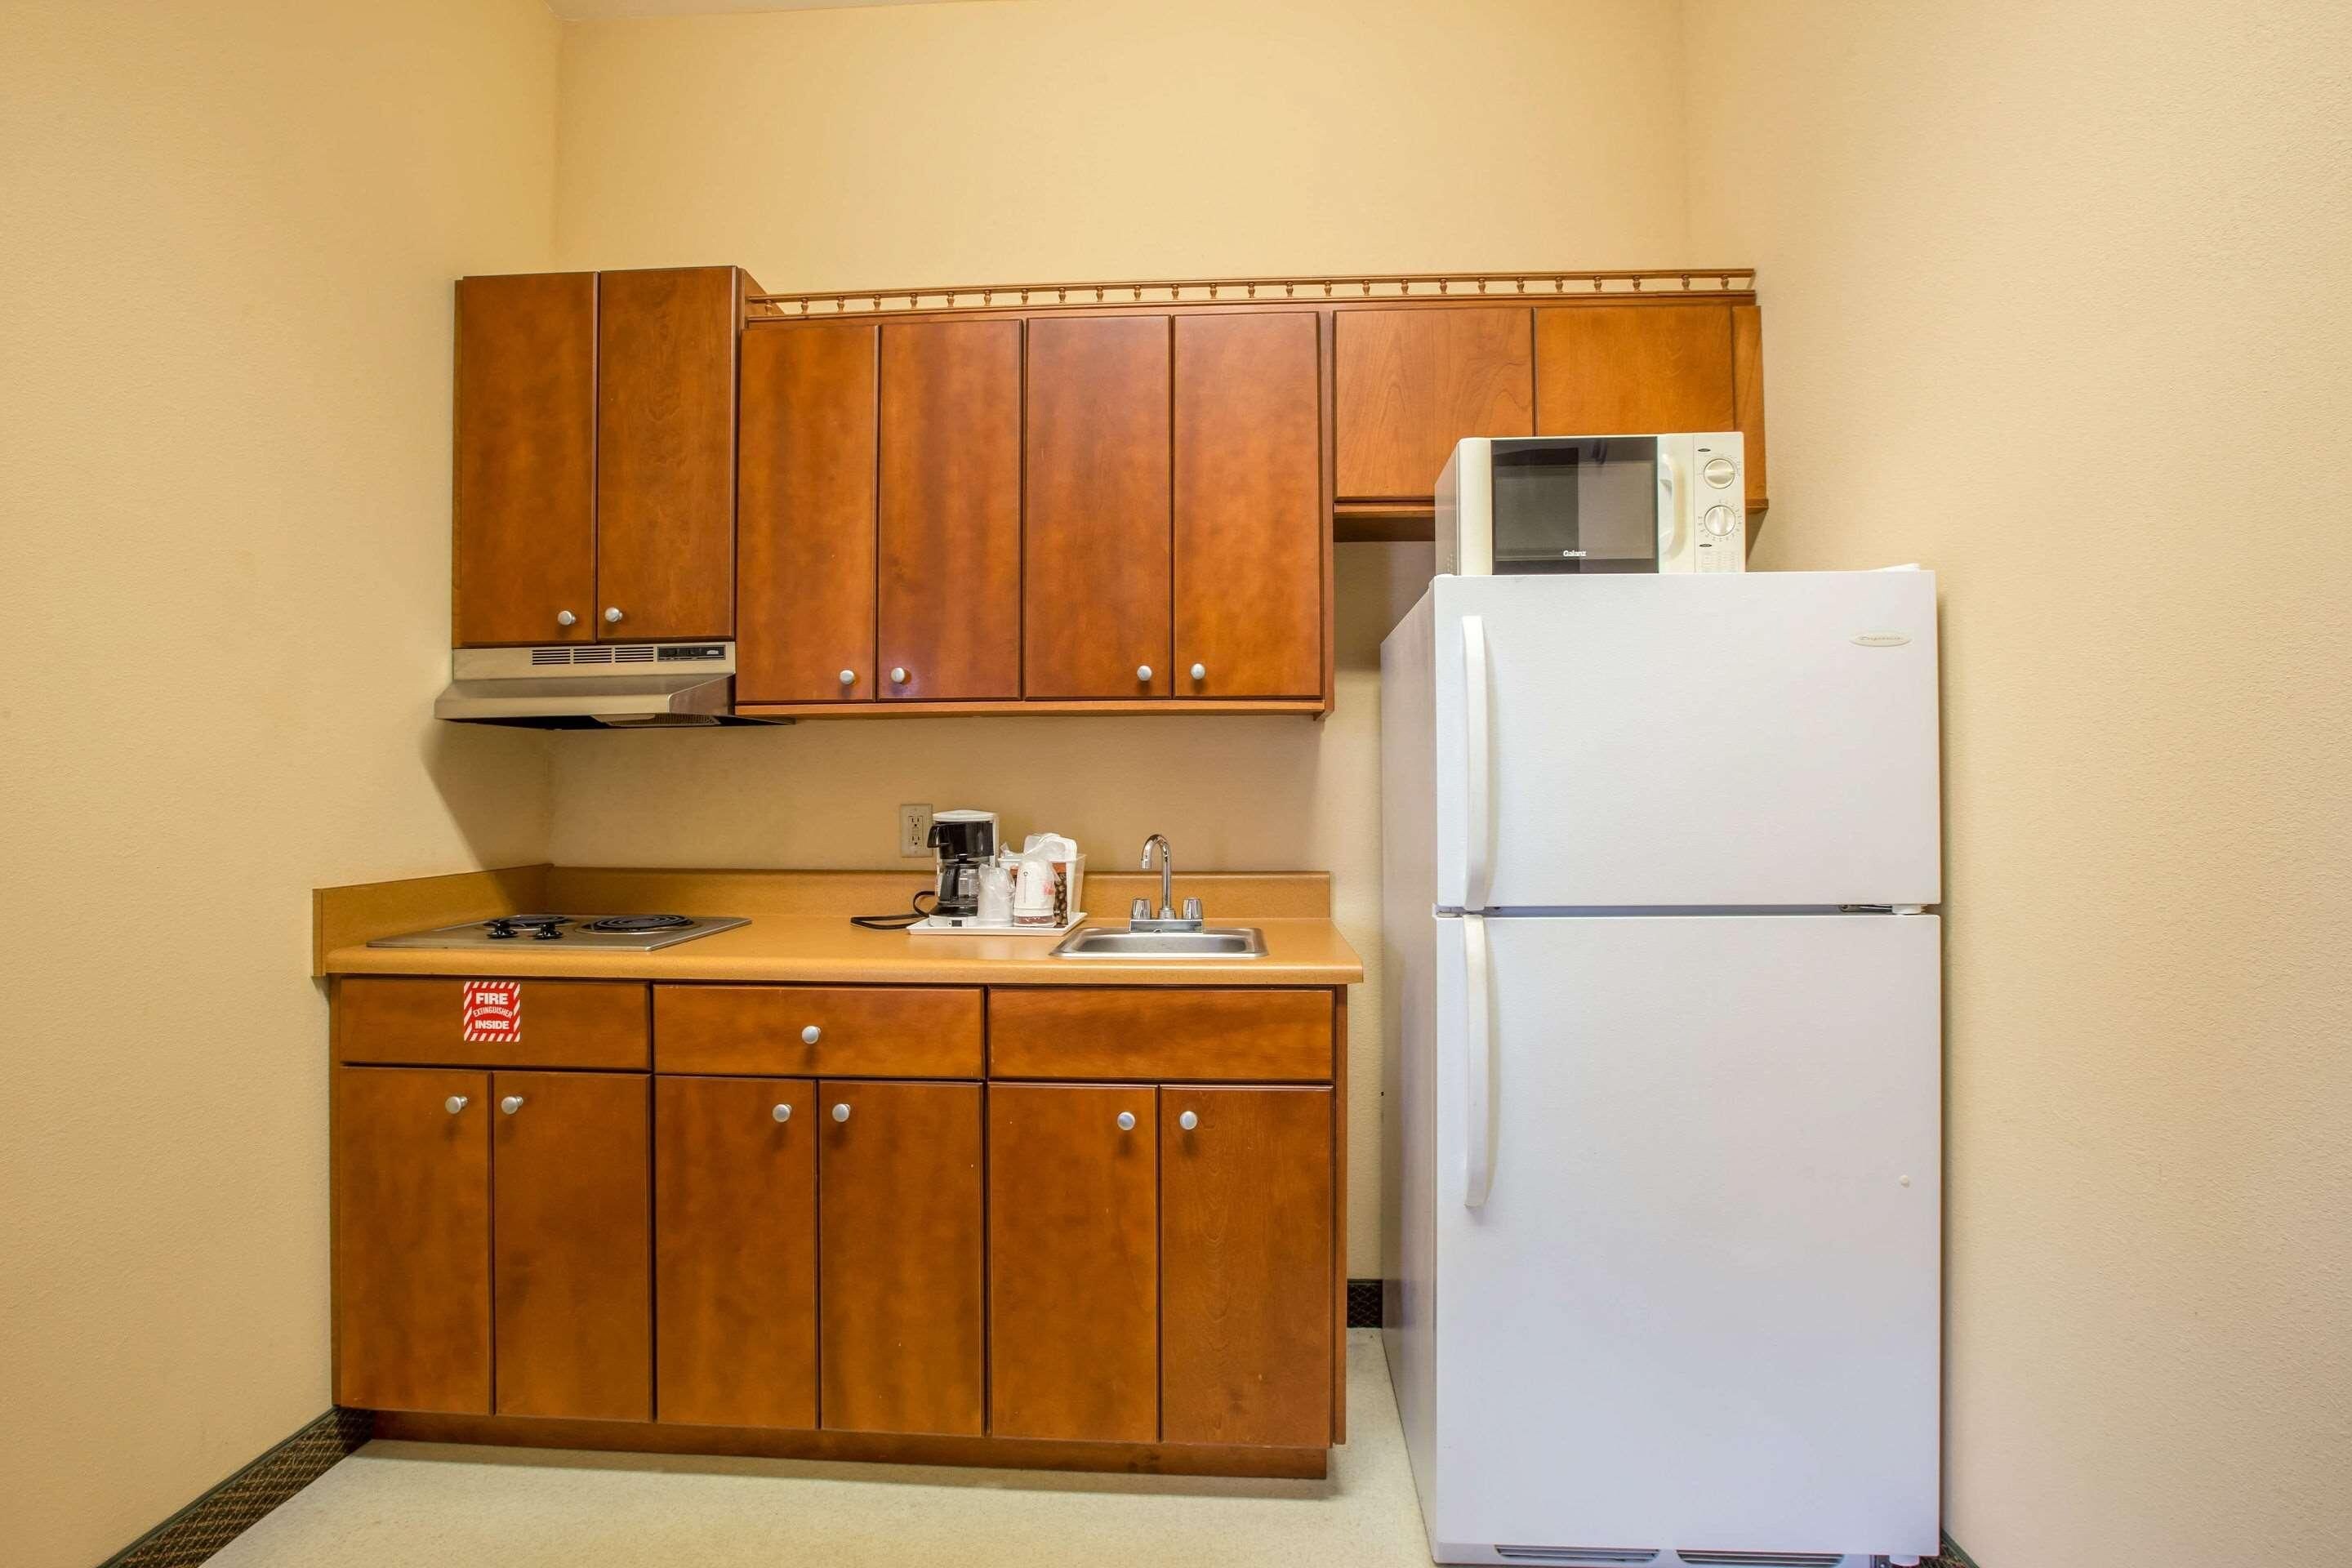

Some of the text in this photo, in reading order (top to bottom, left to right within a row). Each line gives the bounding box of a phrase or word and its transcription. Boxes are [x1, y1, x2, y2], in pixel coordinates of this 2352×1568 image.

[475, 992, 509, 1005] FIRE
[473, 1006, 513, 1018] EXTINGUISHER
[474, 1020, 510, 1030] INSIDE
